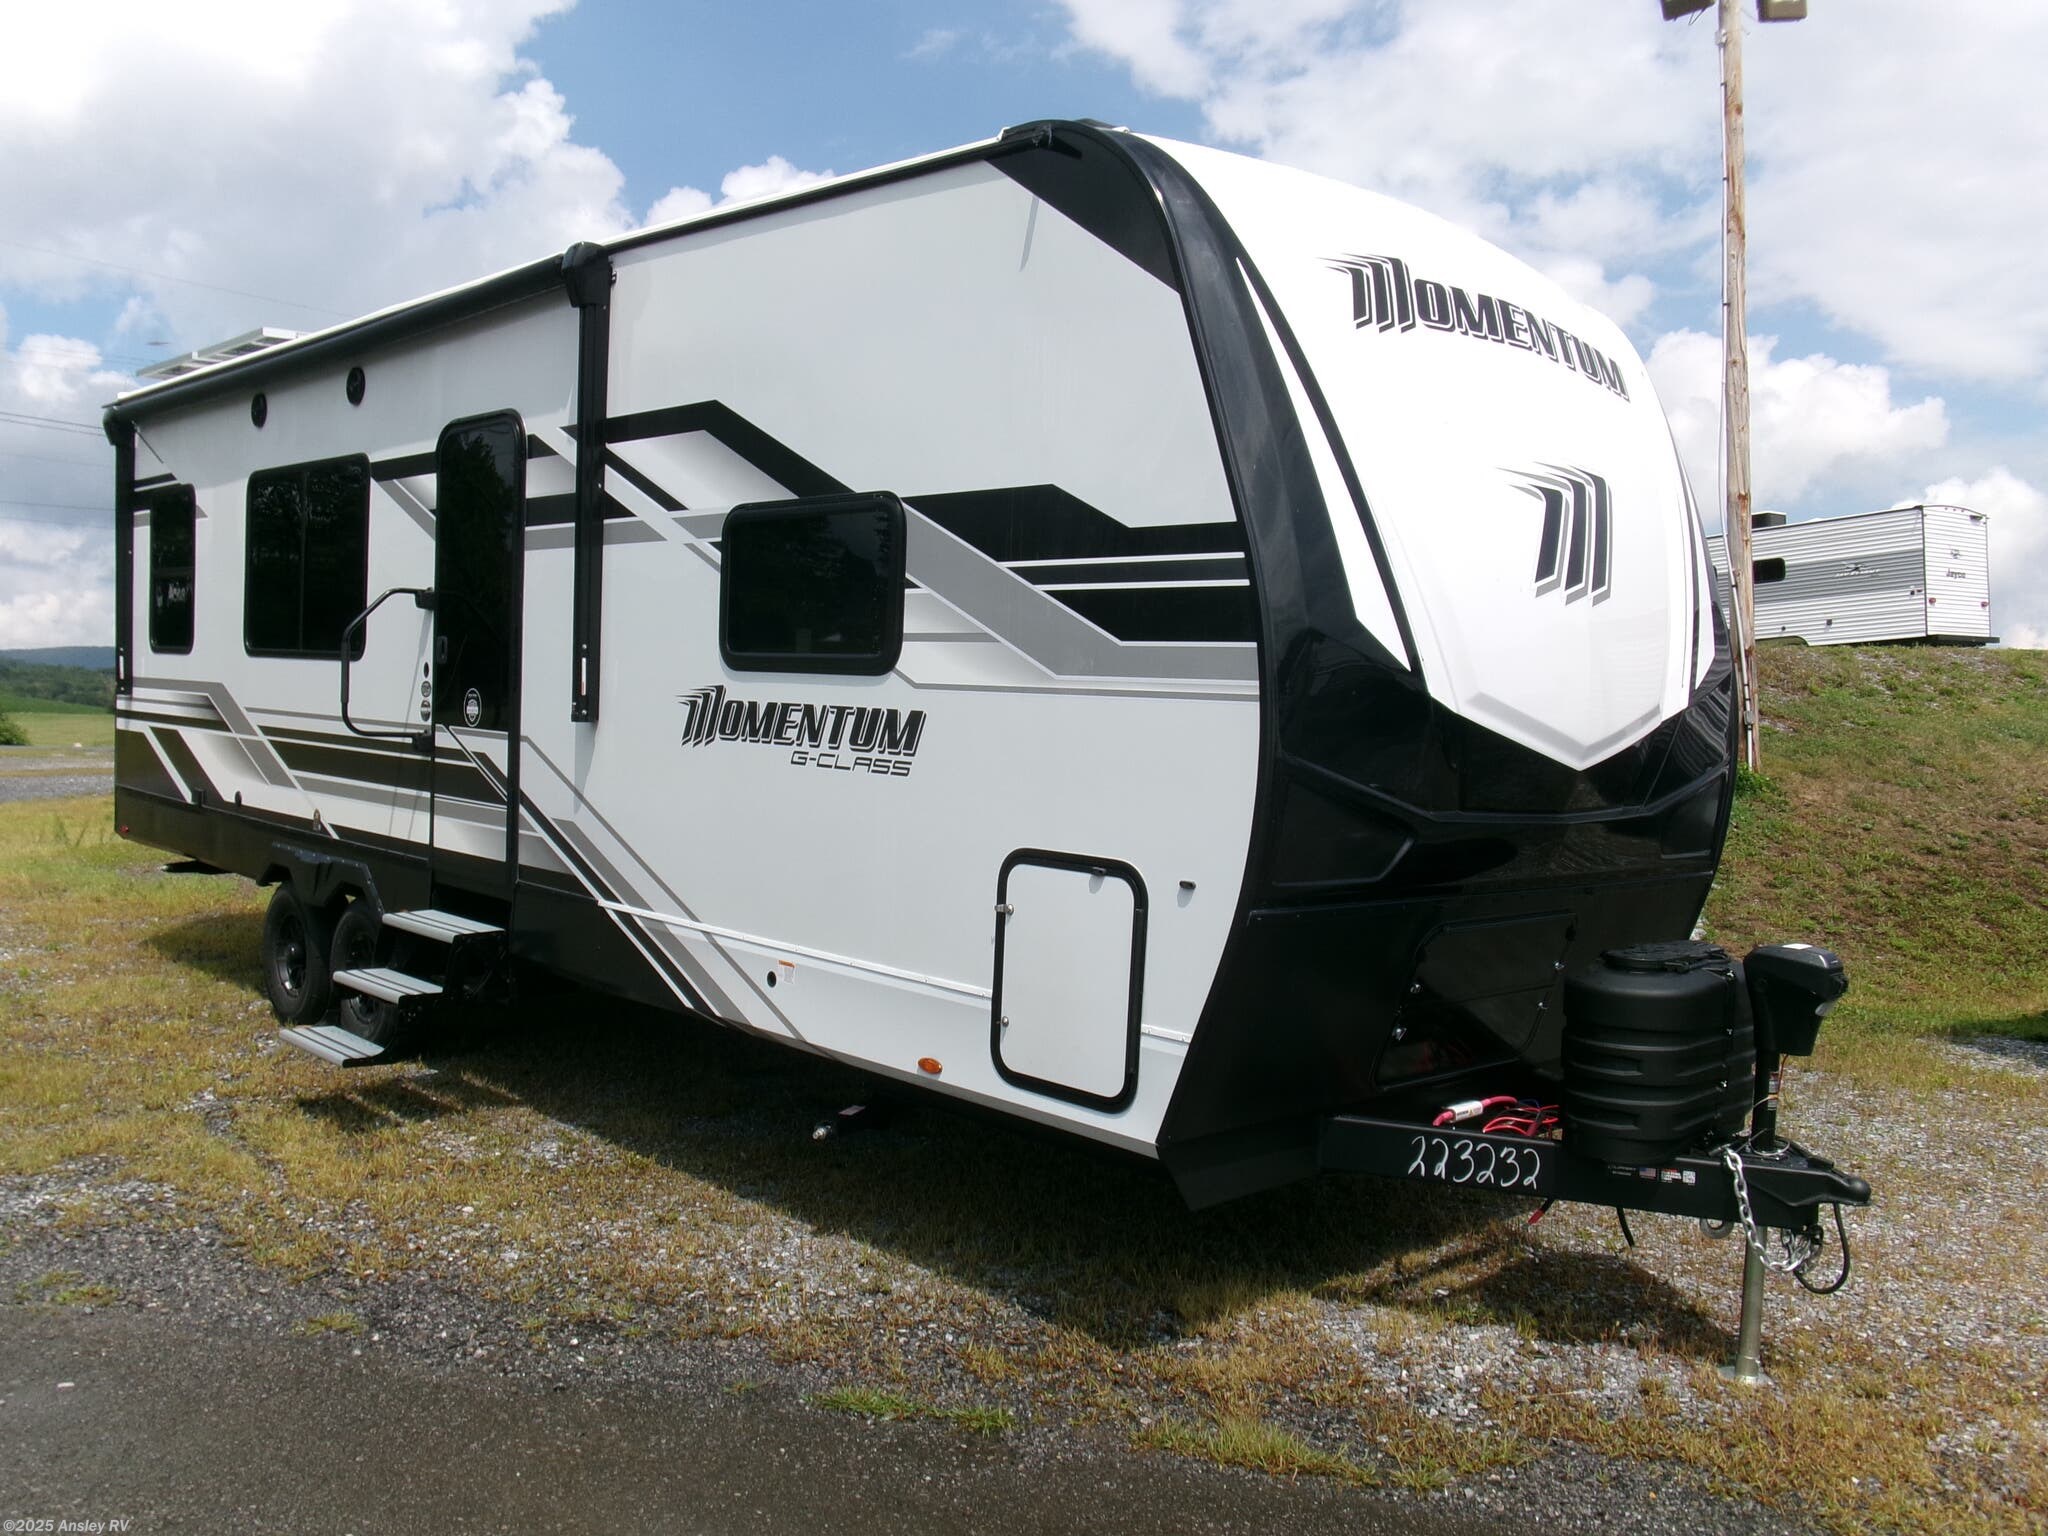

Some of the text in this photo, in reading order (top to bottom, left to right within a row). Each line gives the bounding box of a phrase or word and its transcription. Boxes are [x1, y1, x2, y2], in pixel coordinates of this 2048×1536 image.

[1315, 253, 1631, 402] MOMENTUM
[676, 684, 927, 757] MOMENTUM
[790, 750, 913, 777] G-CLASS
[1408, 1135, 1540, 1190] 223232
